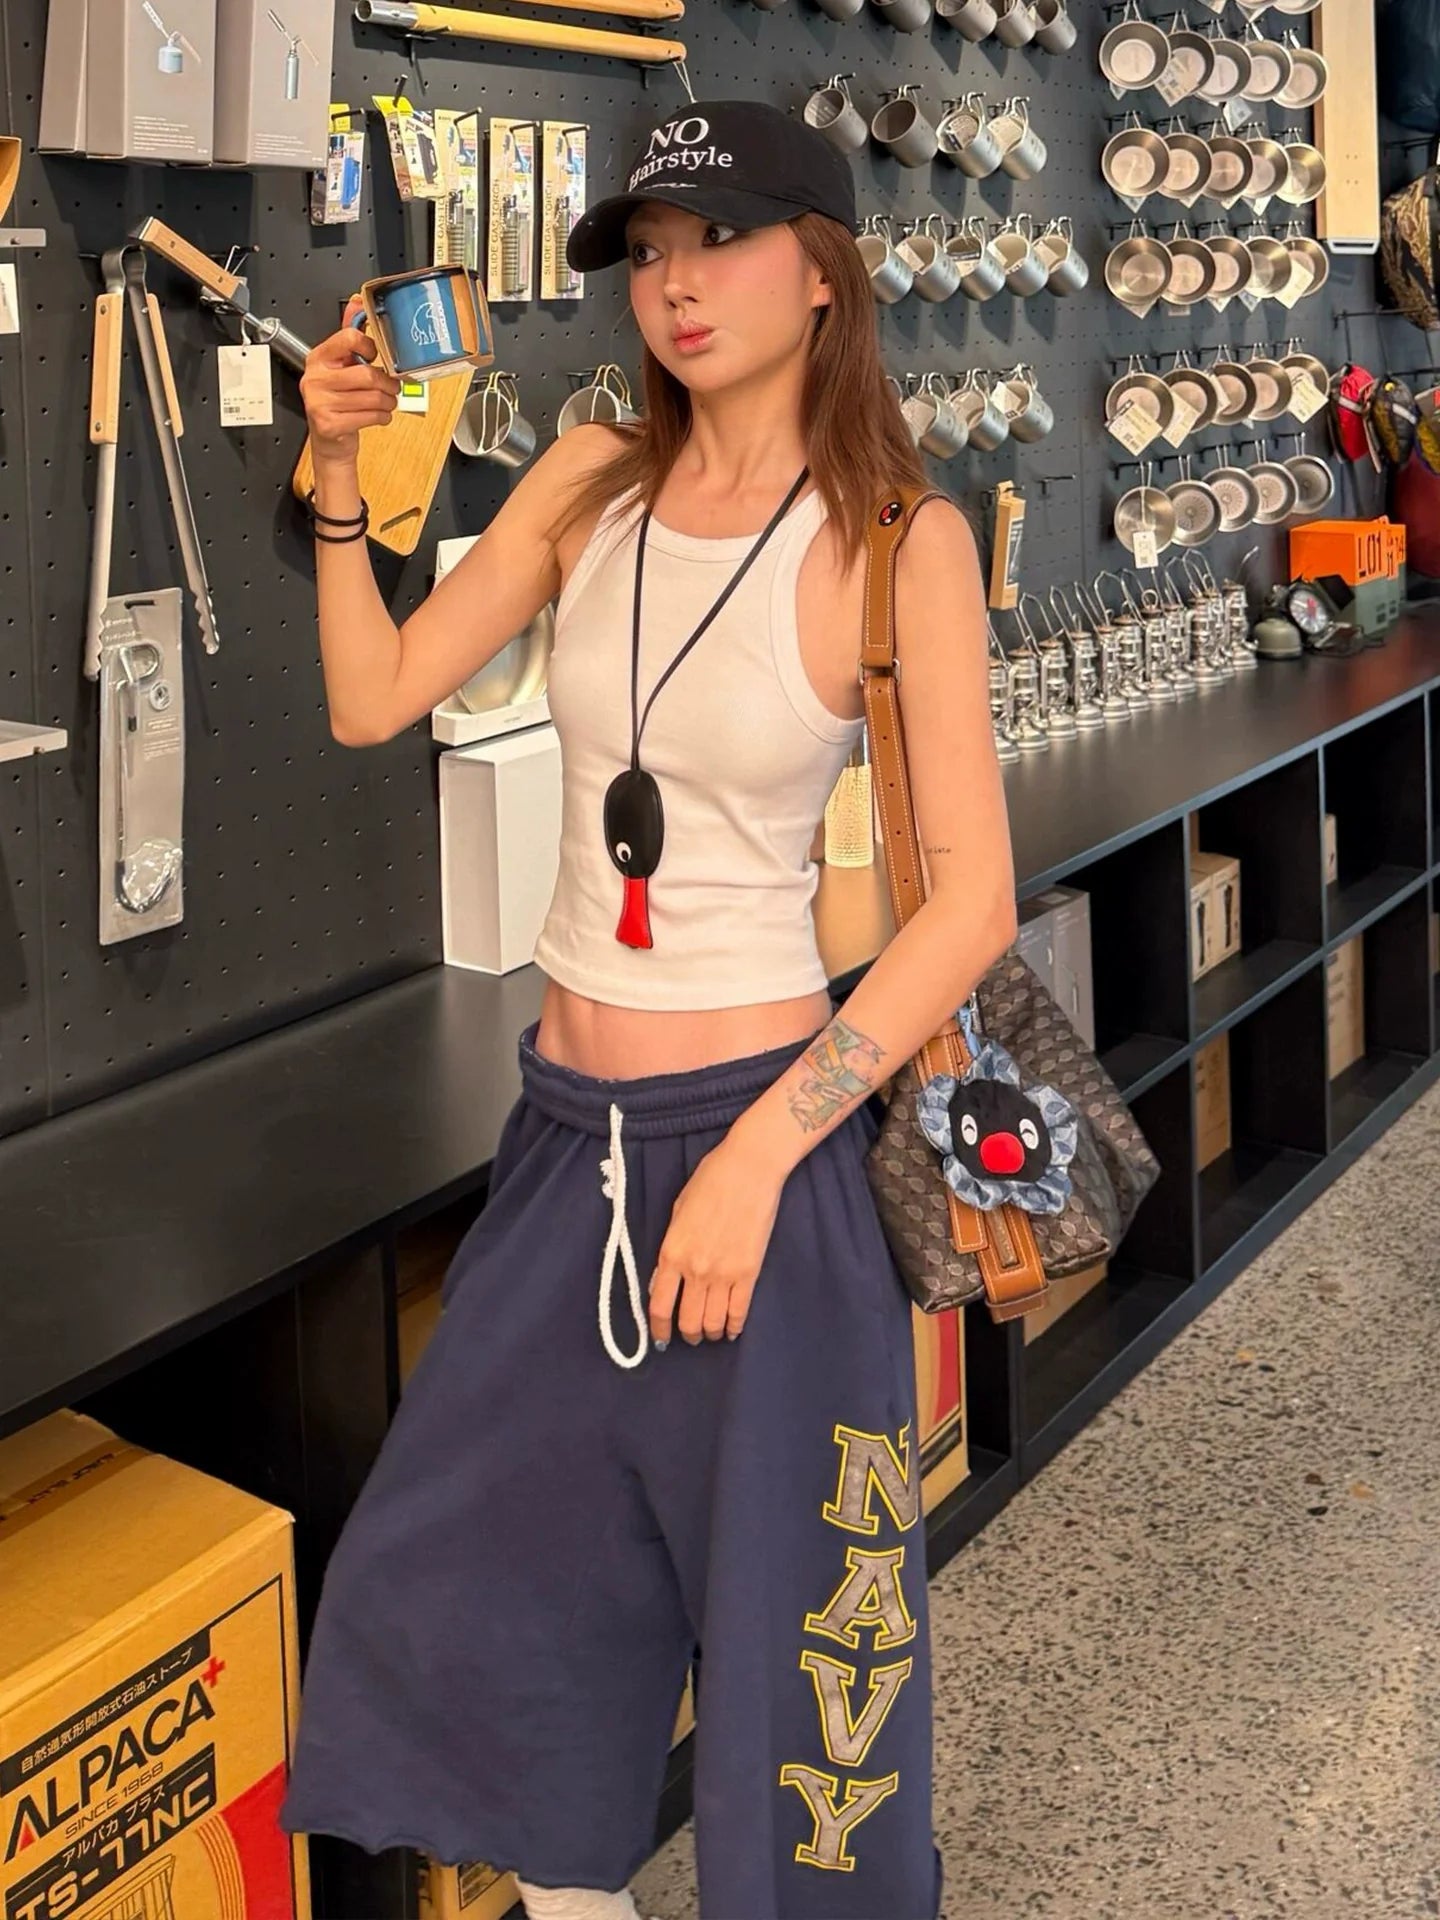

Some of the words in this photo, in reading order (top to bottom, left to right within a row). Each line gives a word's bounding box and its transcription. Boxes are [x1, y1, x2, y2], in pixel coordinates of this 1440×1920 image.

[644, 117, 709, 159] NO
[492, 178, 500, 216] TORCH
[628, 147, 733, 192] Hairstyle
[490, 245, 498, 277] SLIDE
[491, 219, 499, 243] GAS
[780, 1418, 918, 1872] NAVY
[21, 1647, 193, 1774] 自然通気形開放式石油ストーブ
[62, 1818, 119, 1868] アルパカ
[125, 1784, 166, 1822] プラス
[65, 1794, 118, 1840] SINCE
[122, 1761, 164, 1798] 1968
[15, 1771, 210, 1920] TS-77NC
